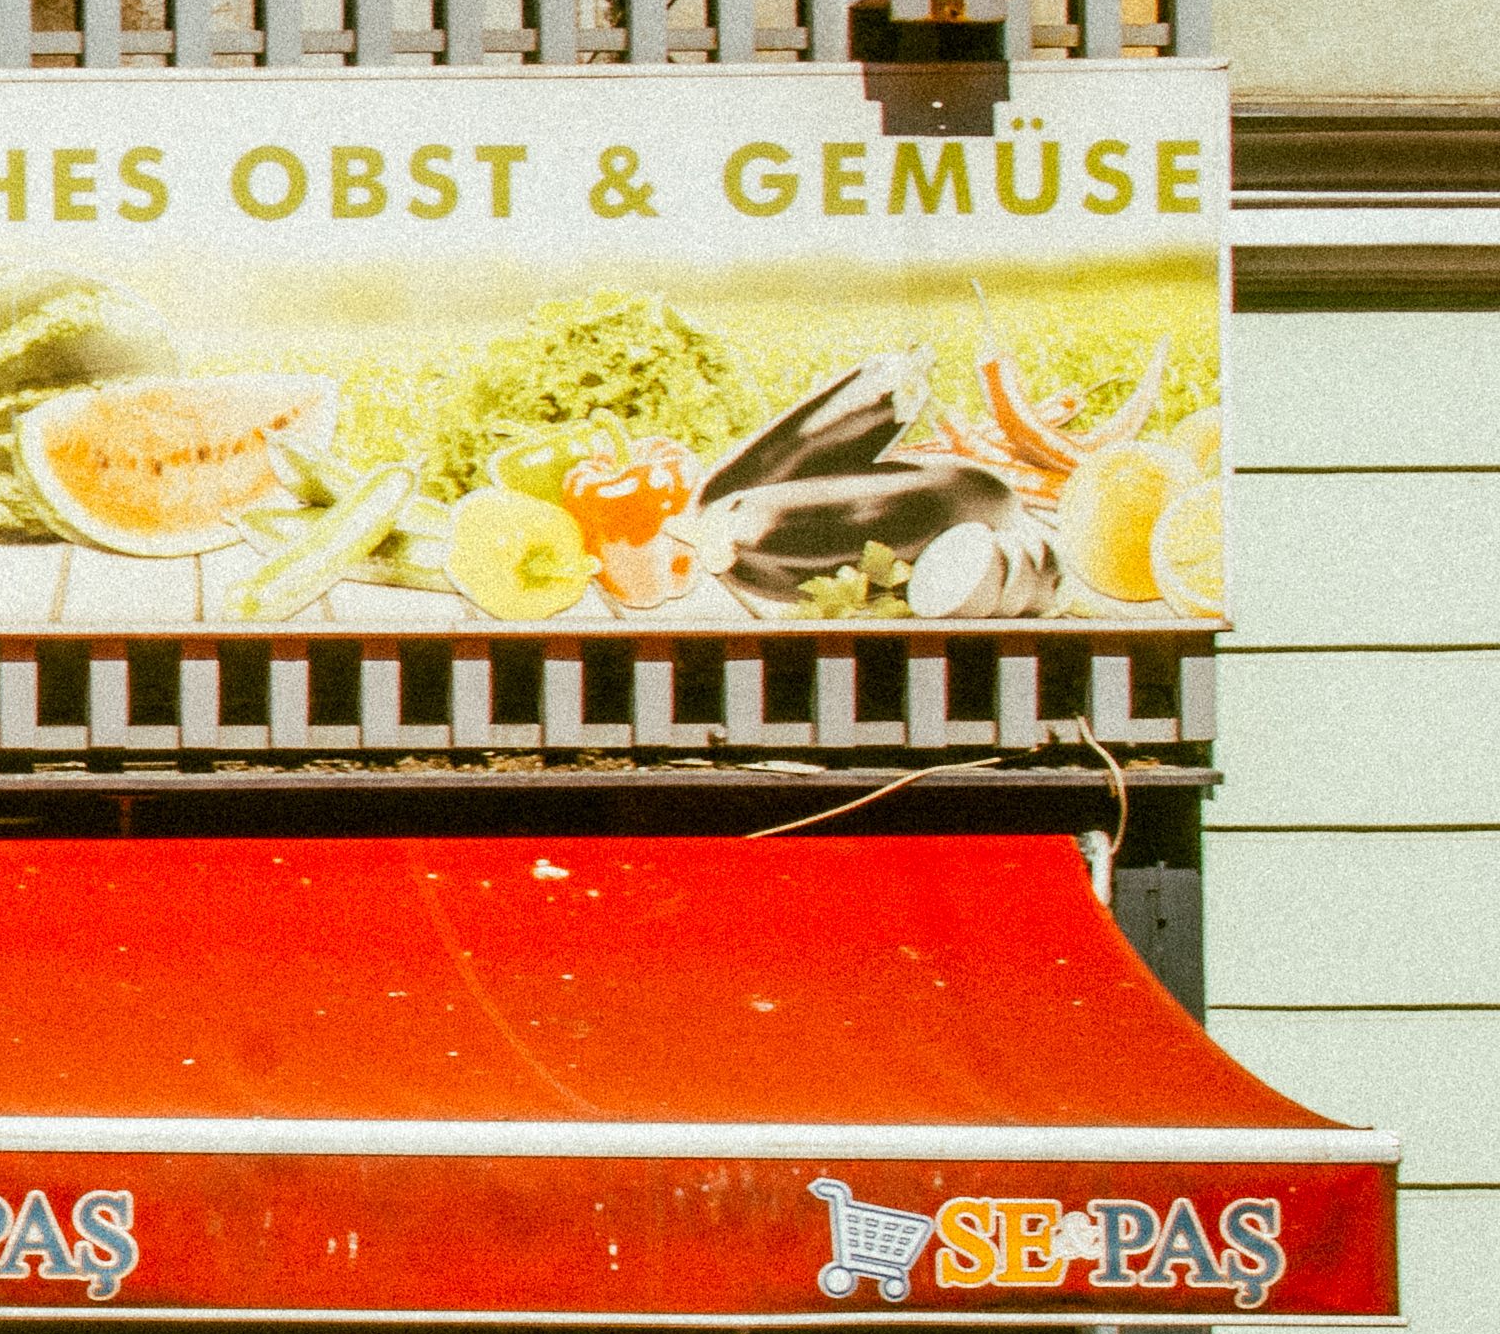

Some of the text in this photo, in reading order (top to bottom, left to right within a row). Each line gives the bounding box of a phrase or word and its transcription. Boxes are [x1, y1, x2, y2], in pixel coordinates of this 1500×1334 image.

[230, 142, 528, 222] OBST
[588, 144, 657, 221] &
[721, 118, 1204, 220] GEMÜSE
